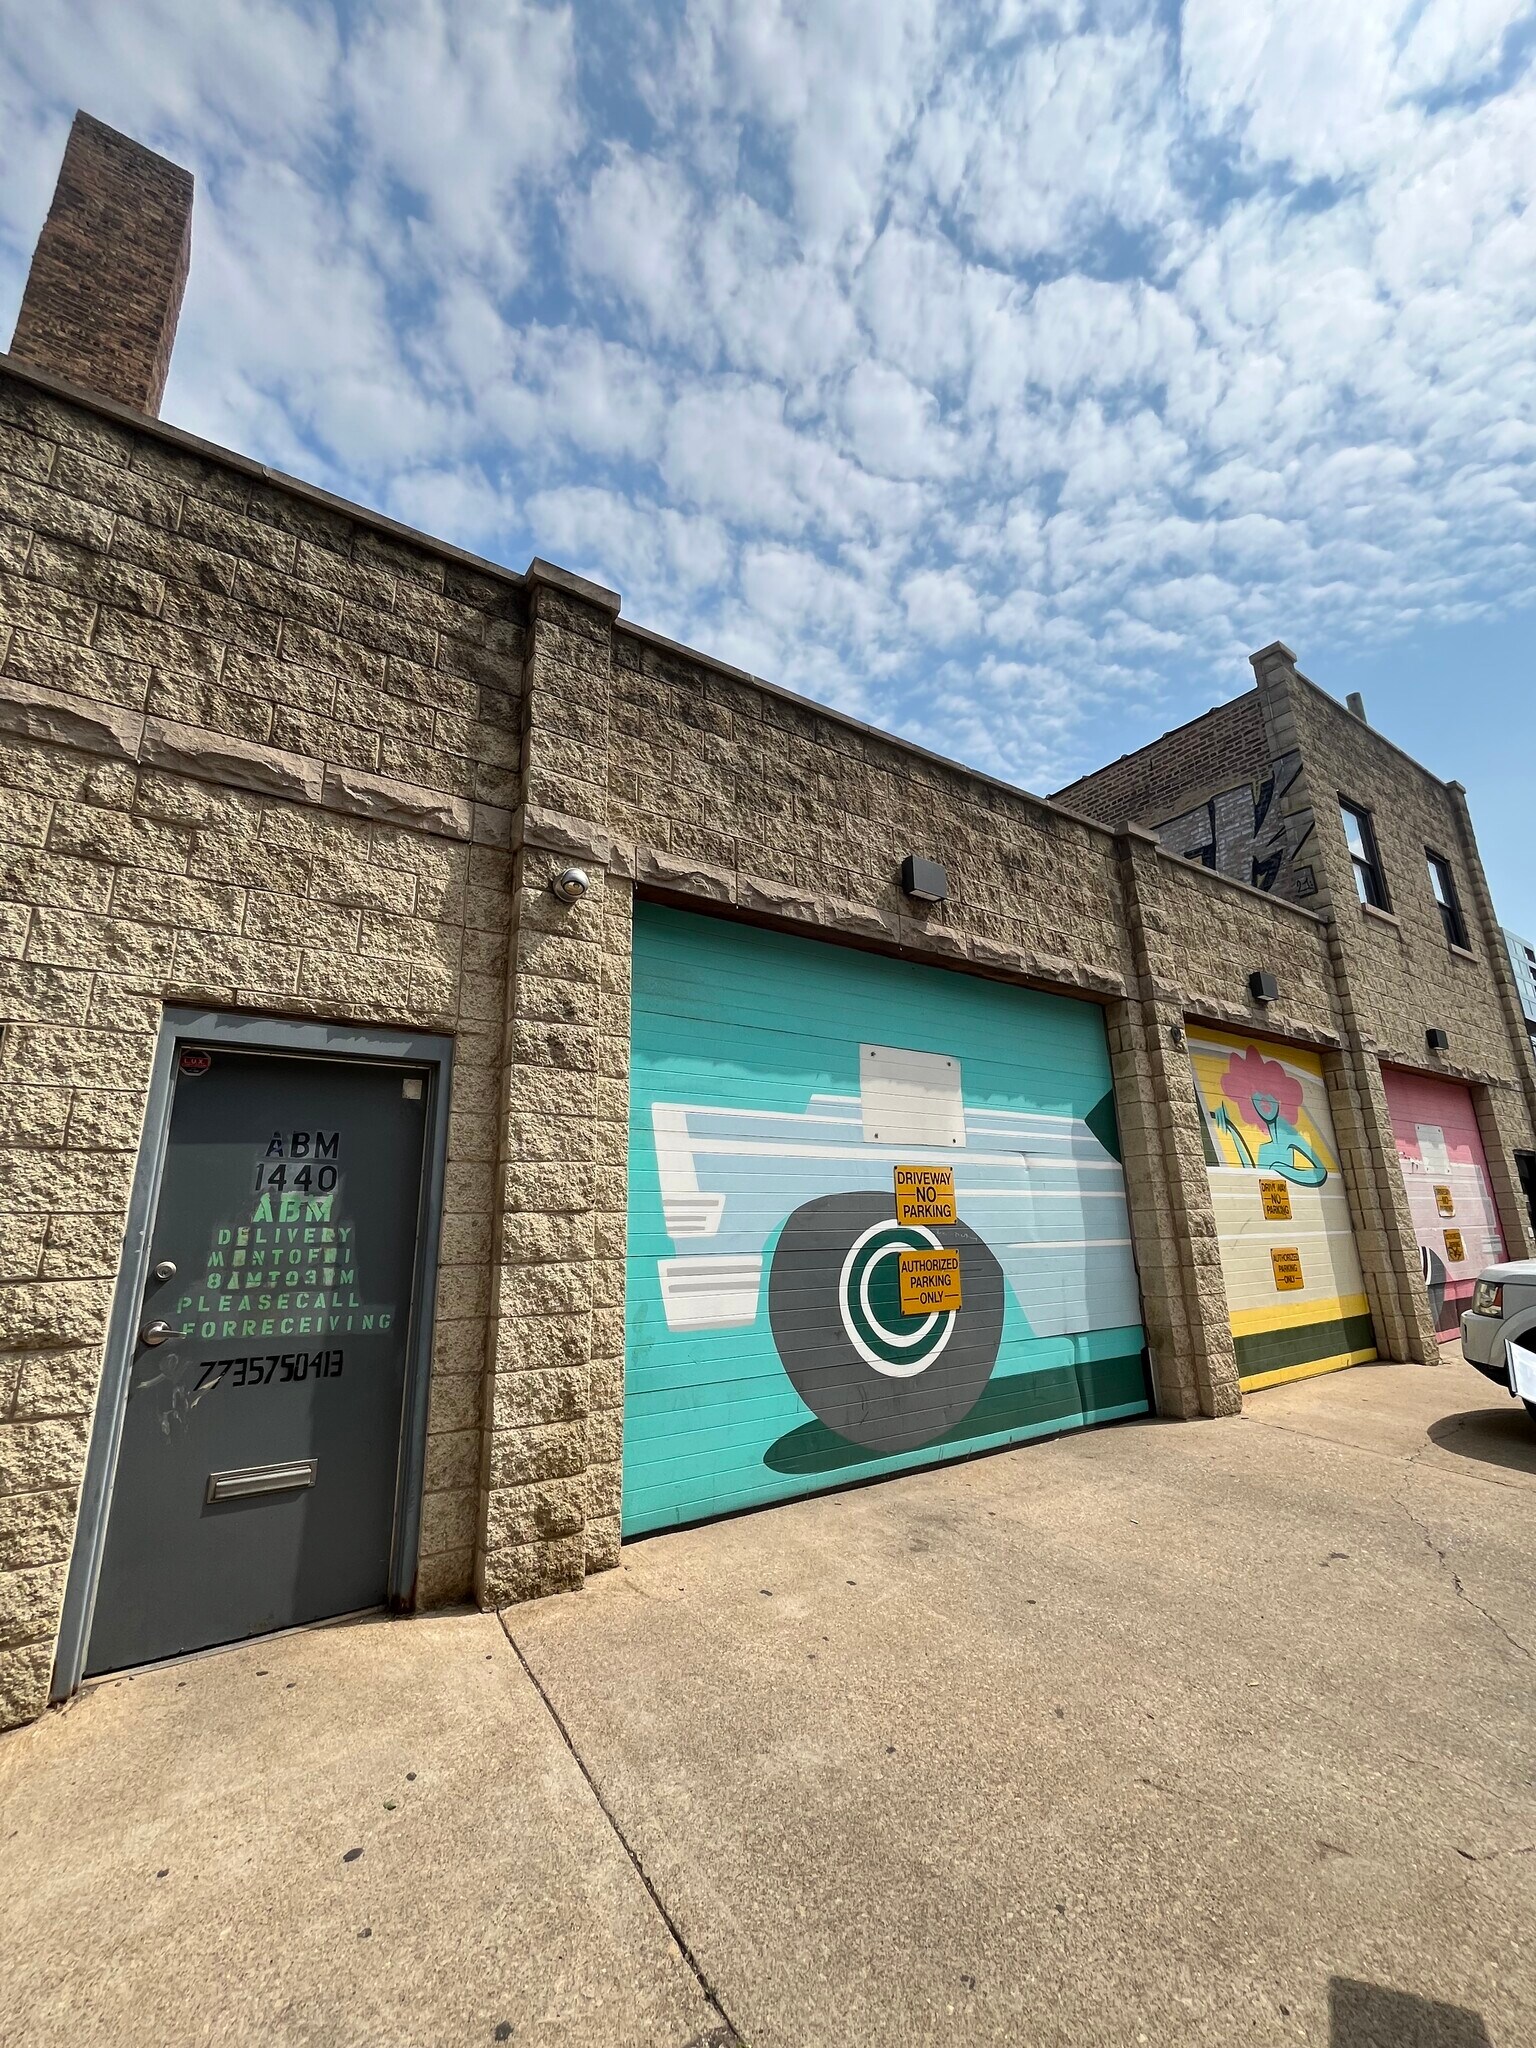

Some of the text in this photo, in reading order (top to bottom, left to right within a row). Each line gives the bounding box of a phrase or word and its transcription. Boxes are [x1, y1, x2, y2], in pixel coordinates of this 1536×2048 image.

[266, 1131, 340, 1158] ABM
[255, 1163, 337, 1192] 1440
[897, 1172, 950, 1185] DRIVEWAY
[916, 1187, 936, 1202] NO
[1271, 1194, 1281, 1204] NO
[252, 1192, 333, 1222] ABM
[904, 1205, 951, 1218] PARKING
[1267, 1205, 1289, 1215] PARKING
[902, 1258, 958, 1273] AUTHORIZED
[910, 1275, 951, 1288] PARKING
[920, 1291, 944, 1304] ONLY
[193, 1350, 344, 1391] 7735750413
